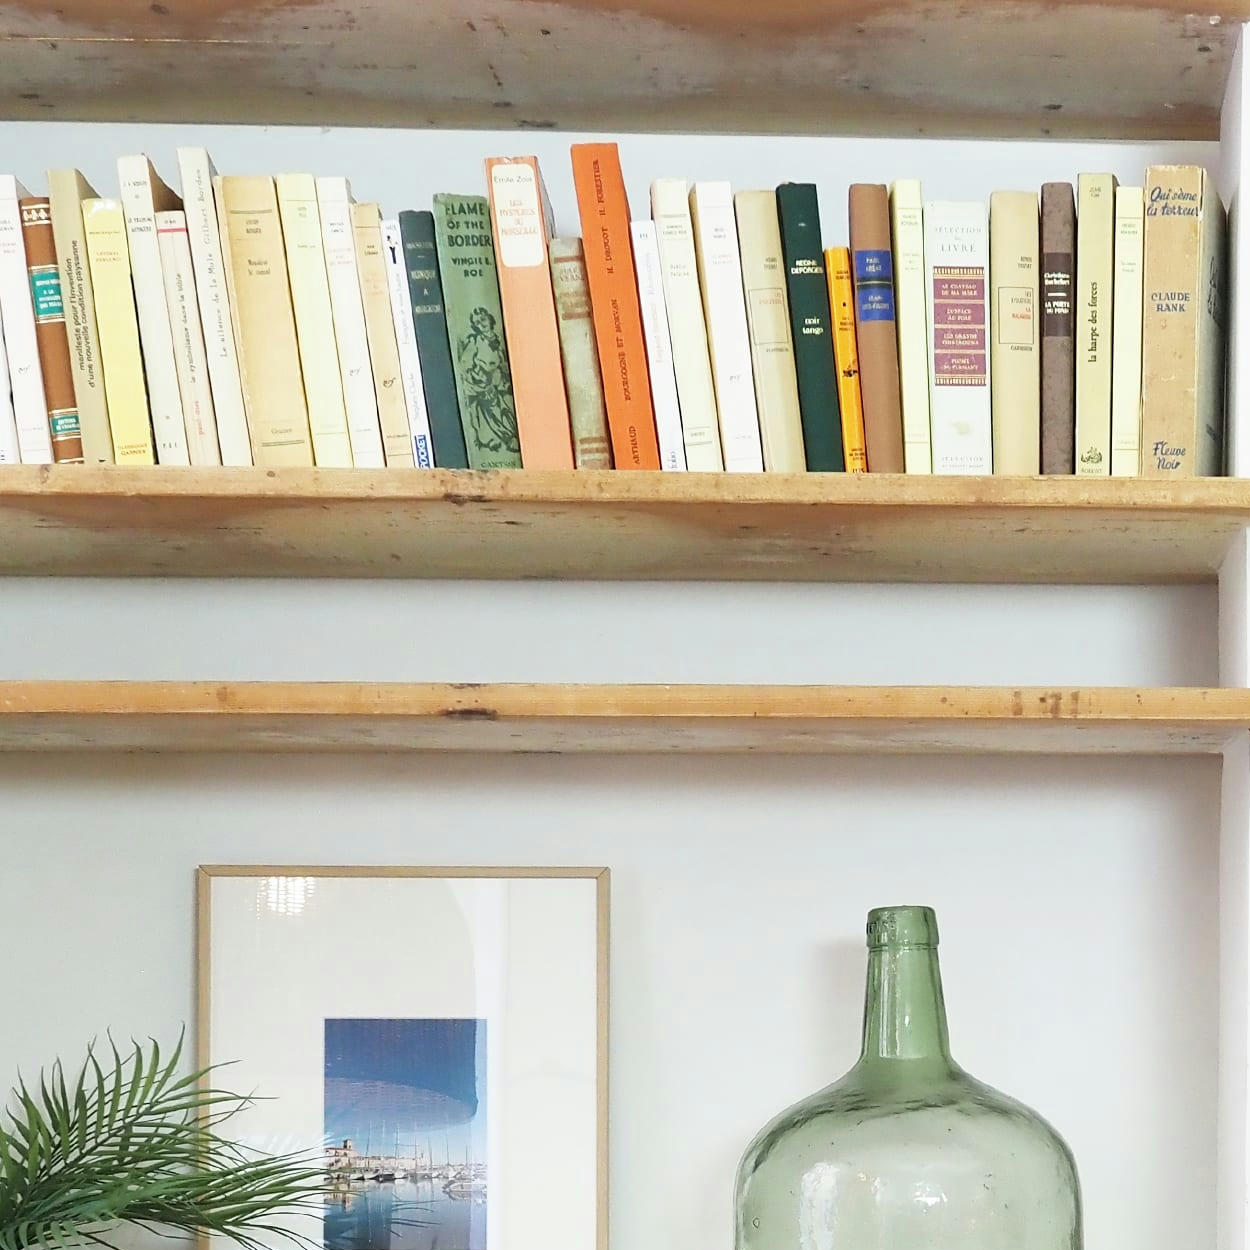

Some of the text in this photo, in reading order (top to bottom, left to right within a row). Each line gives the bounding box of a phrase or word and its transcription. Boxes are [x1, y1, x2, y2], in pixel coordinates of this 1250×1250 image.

[593, 159, 604, 203] FORESTIER
[1150, 186, 1198, 202] Qui sème
[446, 203, 485, 216] FLAME
[1147, 202, 1199, 217] la terreur
[201, 208, 210, 245] Gilbert
[447, 221, 484, 230] OF THE
[448, 234, 492, 247] BORDER
[601, 226, 612, 261] DROUOT
[207, 253, 215, 275] Mule
[791, 267, 824, 275] DEFORGES
[464, 269, 484, 277] ROE
[209, 279, 217, 288] la
[212, 294, 219, 304] de
[1151, 292, 1191, 301] CLAUDE
[66, 258, 84, 371] manifeste pour l'invention
[72, 240, 96, 388] d'une nouvelle condition paysanne
[1156, 303, 1185, 312] RANK
[611, 299, 622, 333] MORVAN
[1088, 281, 1099, 363] la harpe des forces
[802, 326, 823, 335] tango
[616, 337, 624, 348] ET
[220, 346, 228, 358] Le
[618, 352, 631, 401] BOURGOGNE
[628, 426, 640, 465] ARTHAUD
[1153, 440, 1186, 456] Fleuve
[1157, 456, 1181, 470] Noir
